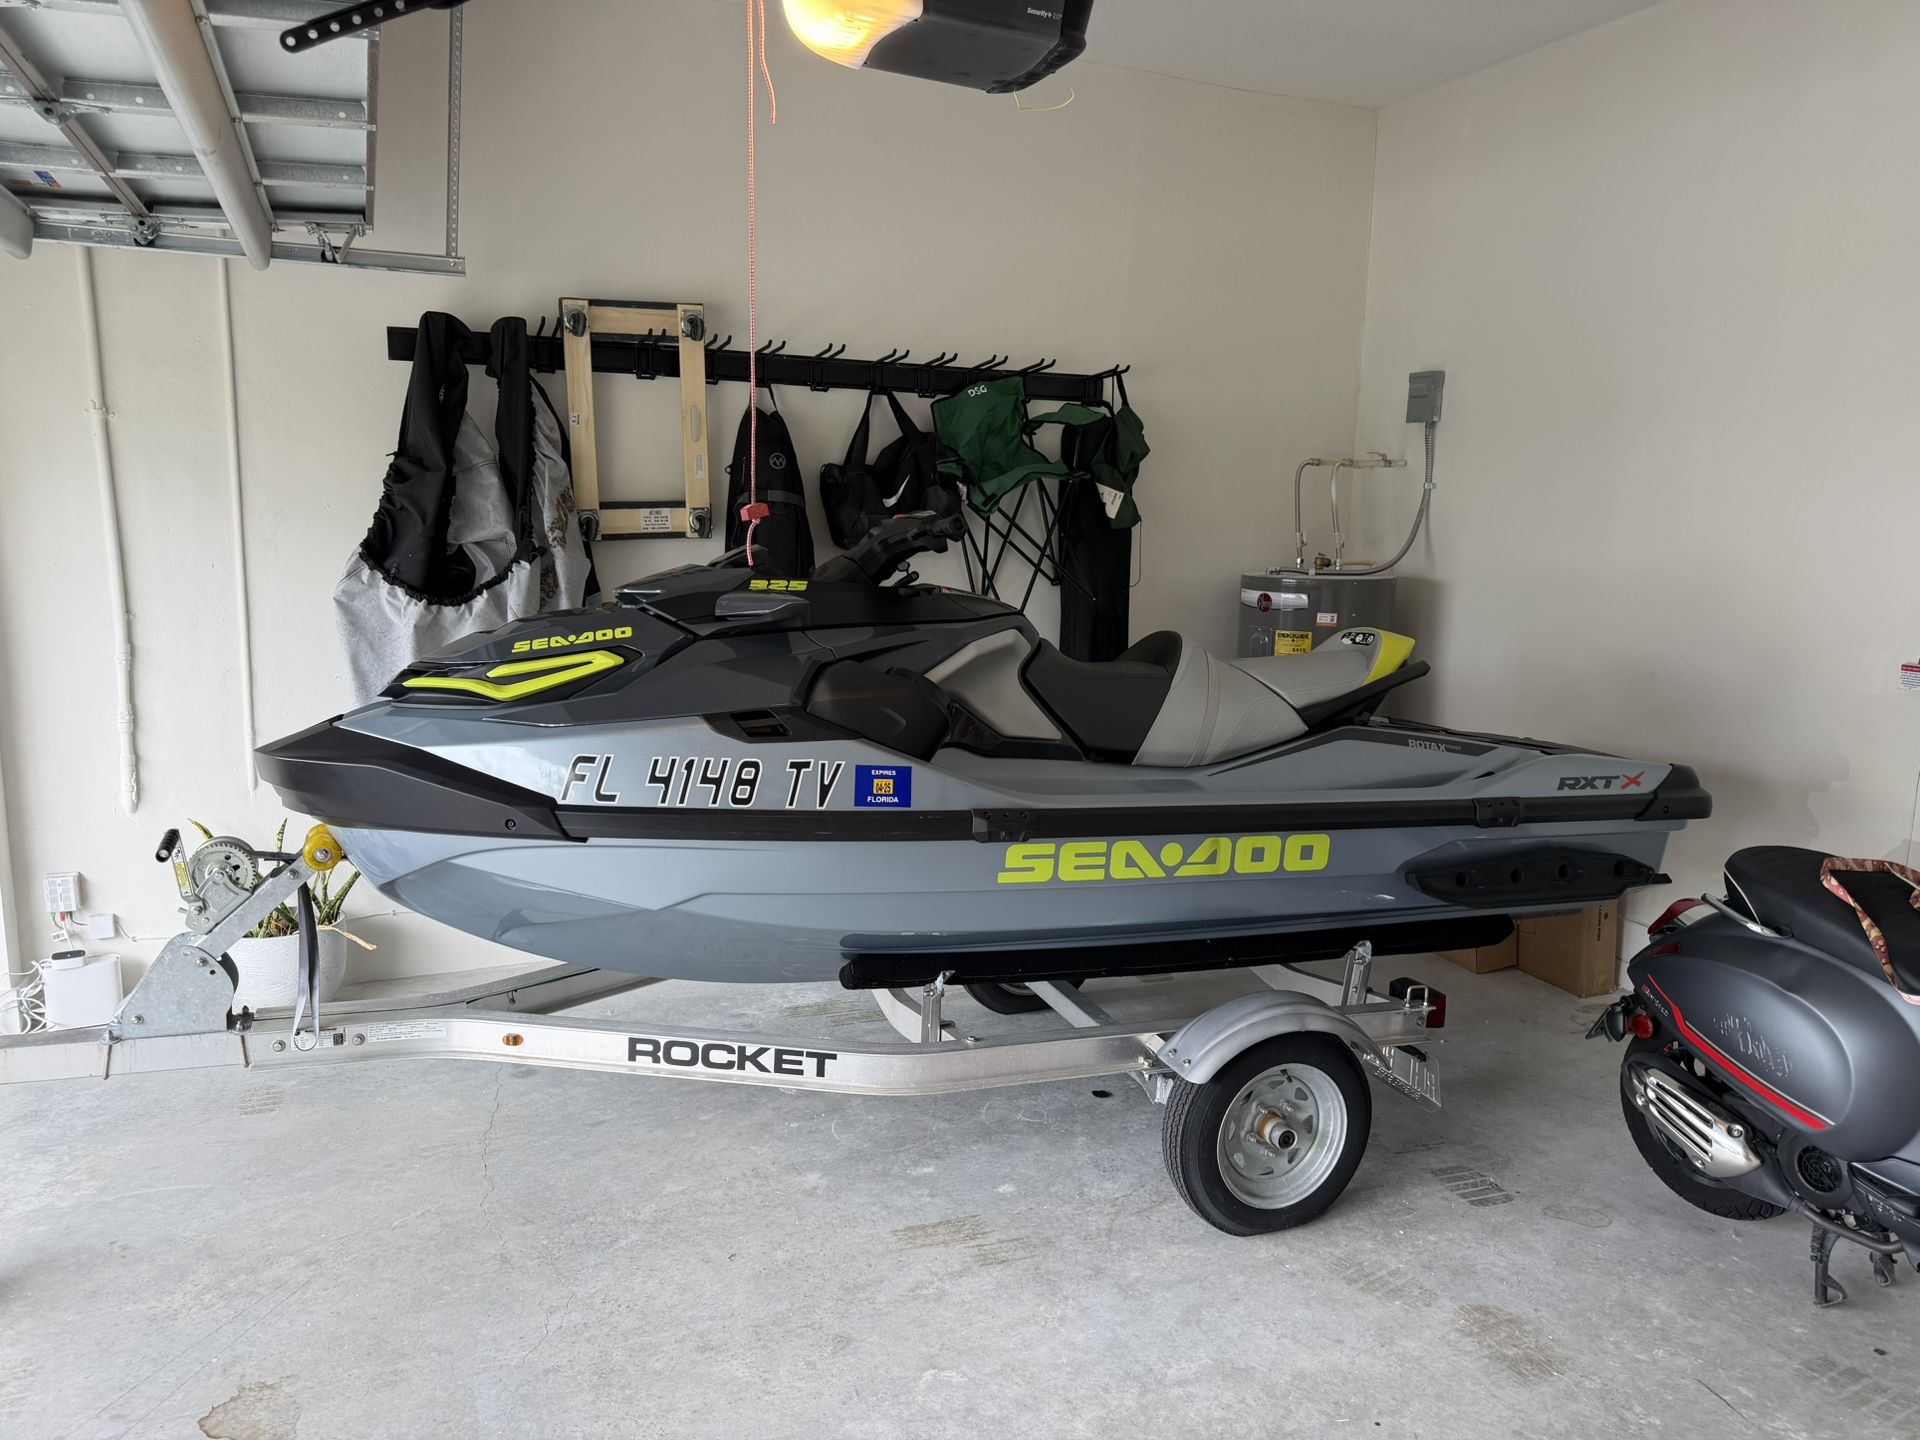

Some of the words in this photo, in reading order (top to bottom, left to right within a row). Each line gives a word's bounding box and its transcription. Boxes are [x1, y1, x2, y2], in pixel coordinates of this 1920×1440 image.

[967, 384, 988, 398] DSG
[749, 579, 808, 592] 325
[1408, 739, 1446, 752] ROTAX
[560, 753, 621, 804] FL
[645, 756, 762, 808] 4148
[785, 759, 846, 810] TV
[1557, 775, 1620, 791] RXT
[628, 1036, 838, 1078] ROCKET
